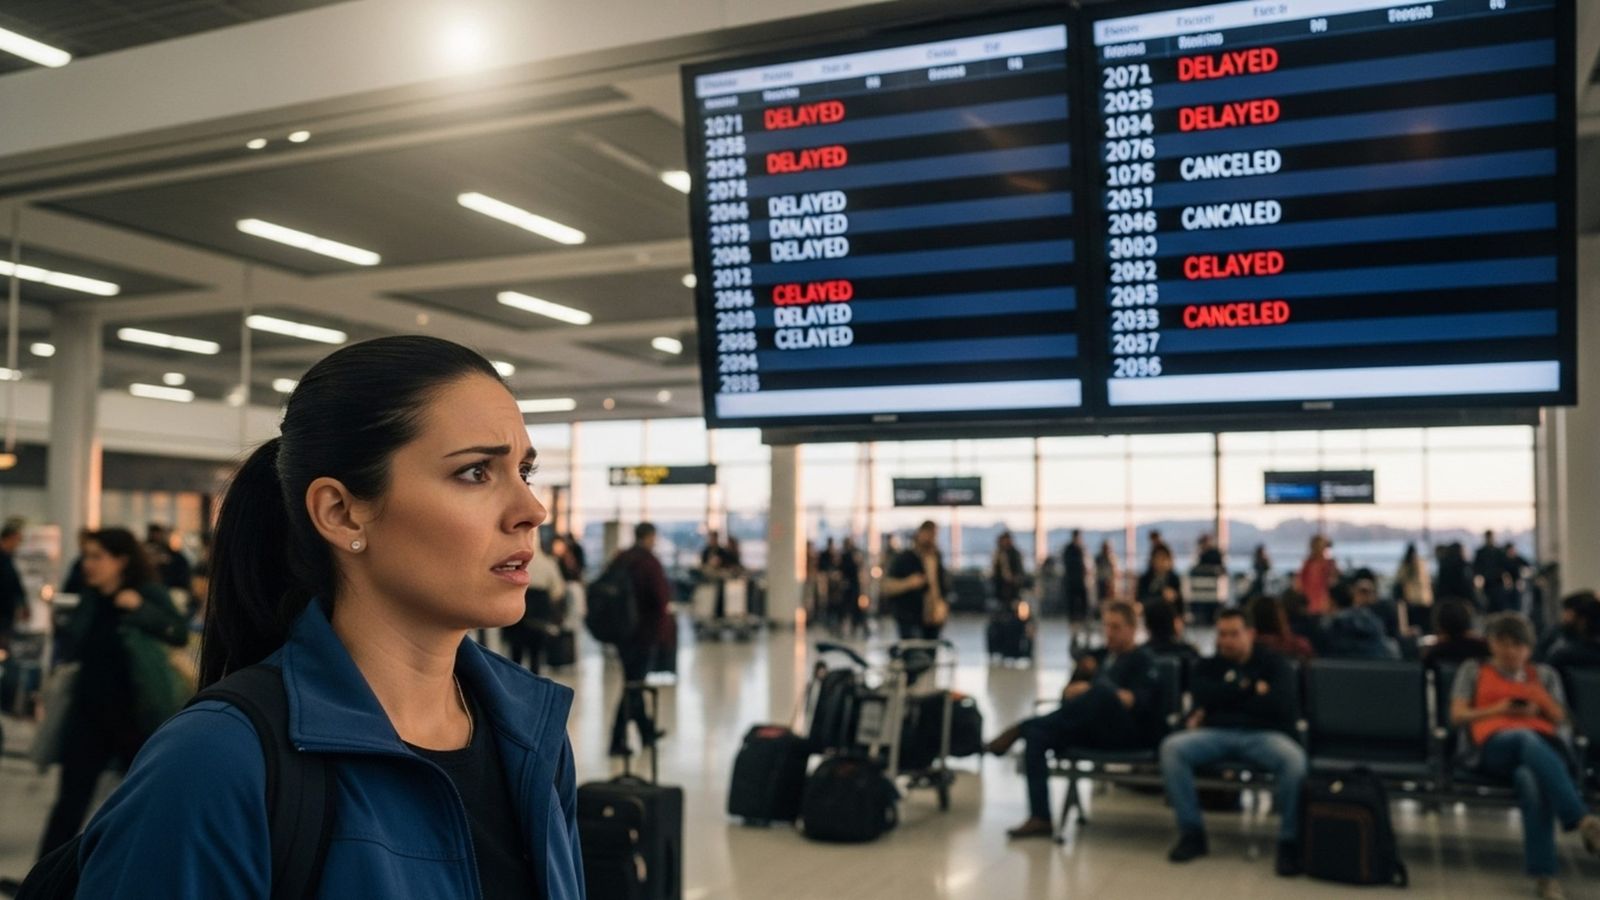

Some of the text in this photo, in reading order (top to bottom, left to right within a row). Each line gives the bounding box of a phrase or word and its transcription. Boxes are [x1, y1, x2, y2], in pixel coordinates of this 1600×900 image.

[1103, 64, 1153, 89] 2071
[1178, 47, 1279, 82] DELAYED
[764, 100, 845, 130] DELAYED
[1179, 99, 1280, 132] DELAYED
[766, 145, 848, 174] DELAYED
[1106, 137, 1156, 162] 2076
[1180, 149, 1282, 181] CANCELED
[768, 190, 847, 218] DELAYED
[1107, 186, 1153, 211] 2051
[770, 236, 849, 262] DELAYED
[1183, 250, 1285, 280] CELAYED
[773, 280, 853, 306] CELAYED
[774, 303, 852, 328] DELAYED
[1183, 300, 1290, 329] CANCELED
[775, 325, 853, 349] CELAYED
